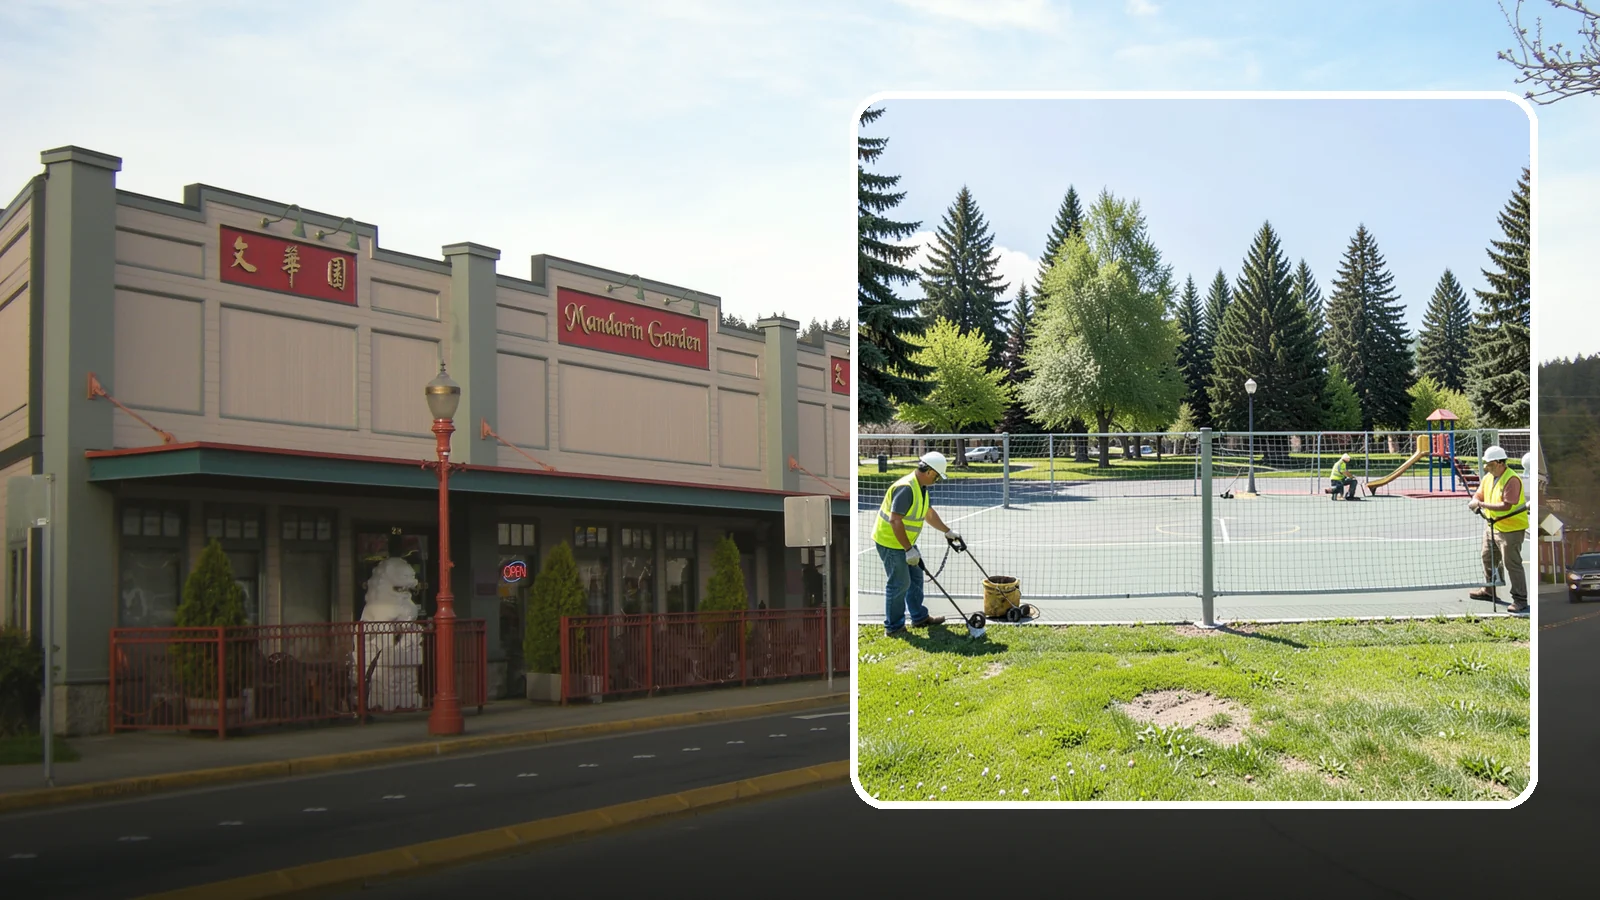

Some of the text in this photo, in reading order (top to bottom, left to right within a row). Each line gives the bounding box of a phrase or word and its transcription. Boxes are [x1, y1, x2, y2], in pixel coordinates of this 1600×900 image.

[231, 235, 347, 291] 文華園
[564, 302, 701, 352] Mandarin Garden
[503, 565, 527, 578] OPEN
